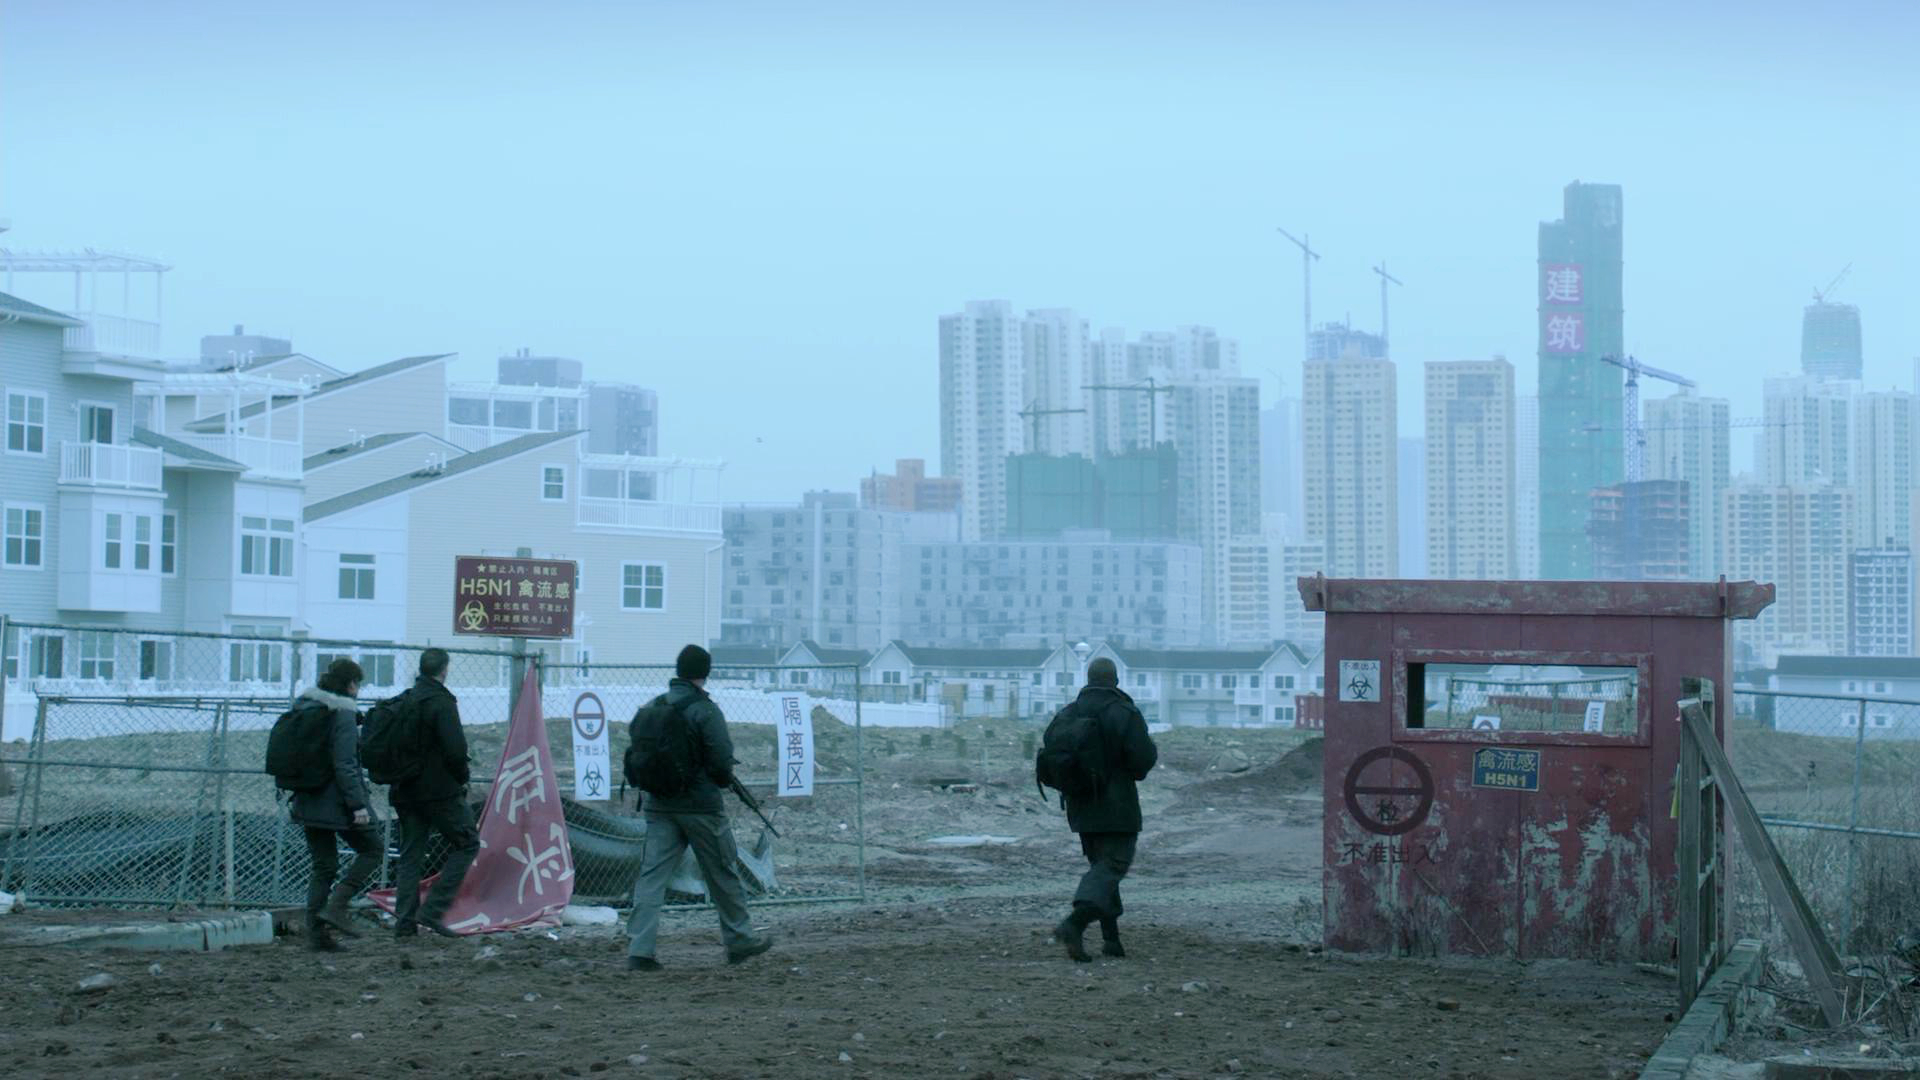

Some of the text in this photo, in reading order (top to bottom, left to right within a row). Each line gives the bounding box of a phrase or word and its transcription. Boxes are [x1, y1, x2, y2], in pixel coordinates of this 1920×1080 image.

[1545, 266, 1581, 350] 建筑
[460, 577, 571, 599] H5N1 禽流感
[782, 696, 804, 790] 隔离区
[1479, 750, 1536, 772] 禽流感
[1485, 772, 1527, 788] H5N1
[1343, 840, 1436, 865] 不准出入
